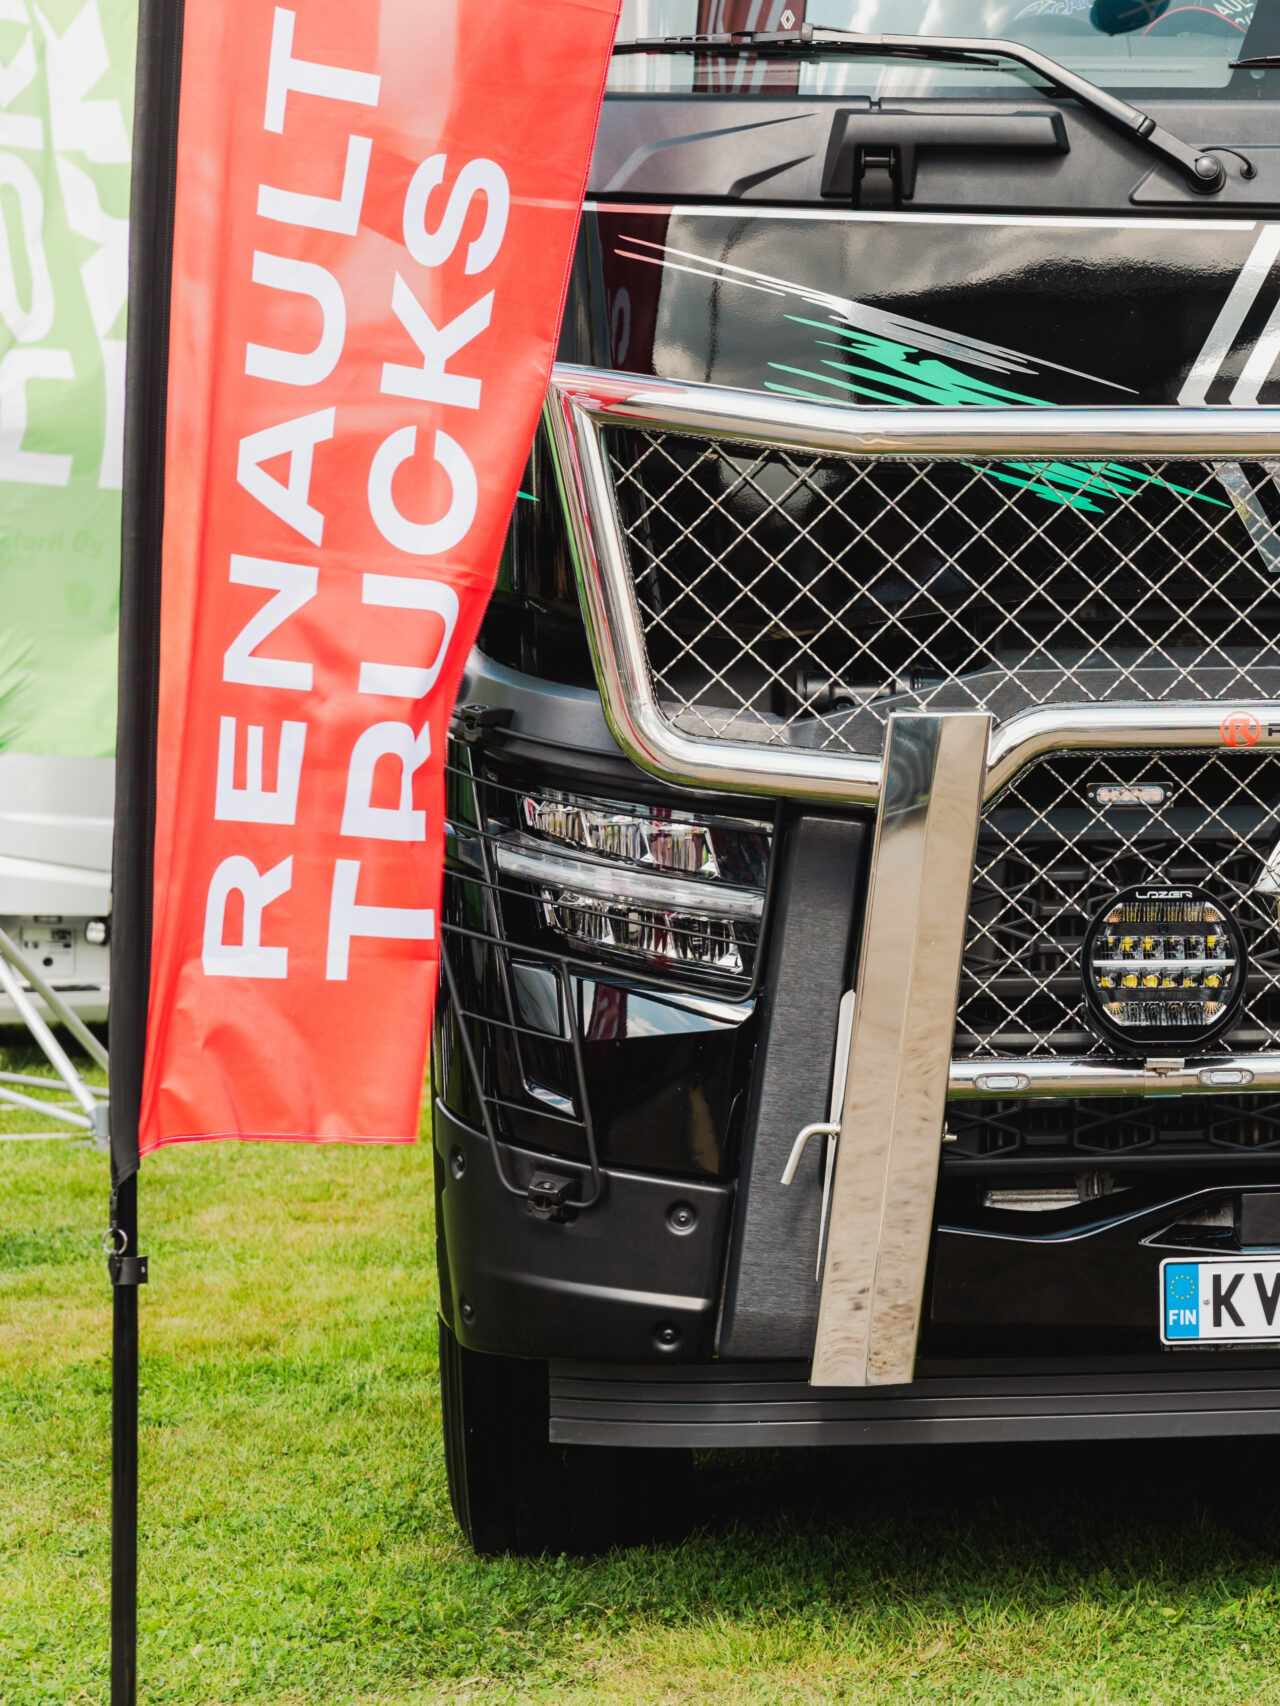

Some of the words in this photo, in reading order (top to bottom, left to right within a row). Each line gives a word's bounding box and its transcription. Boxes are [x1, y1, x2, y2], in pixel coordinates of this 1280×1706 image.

[202, 6, 381, 978] RENAULT
[326, 153, 510, 981] TRUCKS
[1168, 1309, 1197, 1326] FIN
